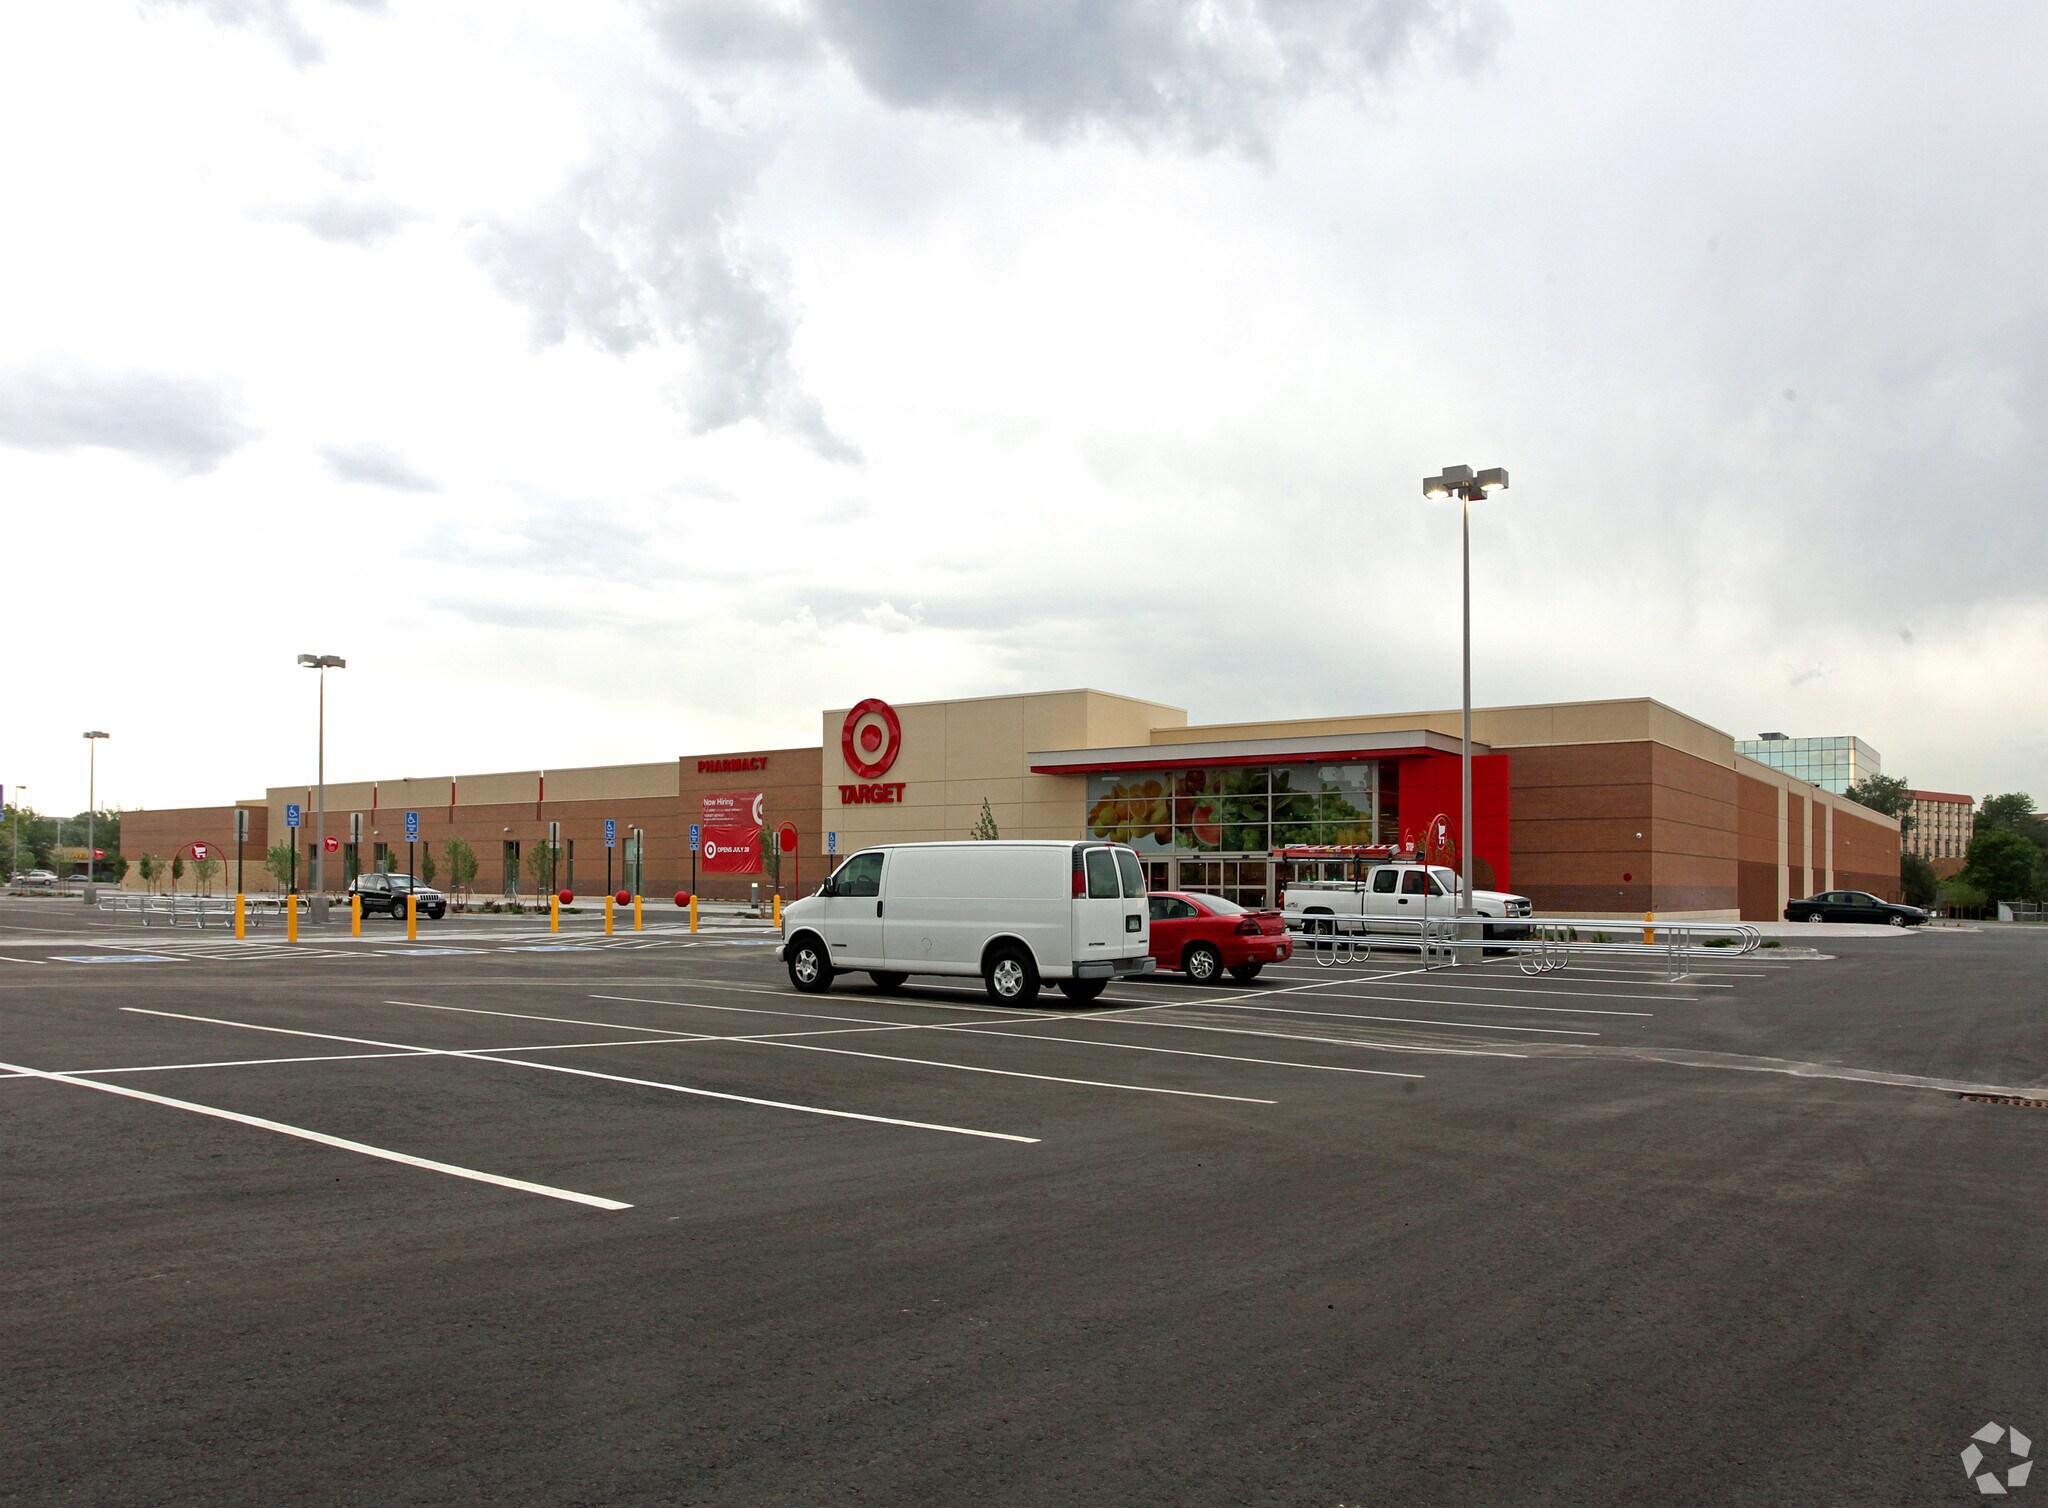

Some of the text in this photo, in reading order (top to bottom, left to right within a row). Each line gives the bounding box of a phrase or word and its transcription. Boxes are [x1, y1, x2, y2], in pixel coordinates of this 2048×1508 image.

[698, 757, 768, 773] PHARMACY
[838, 783, 906, 804] TARGET
[717, 797, 733, 807] Hiring
